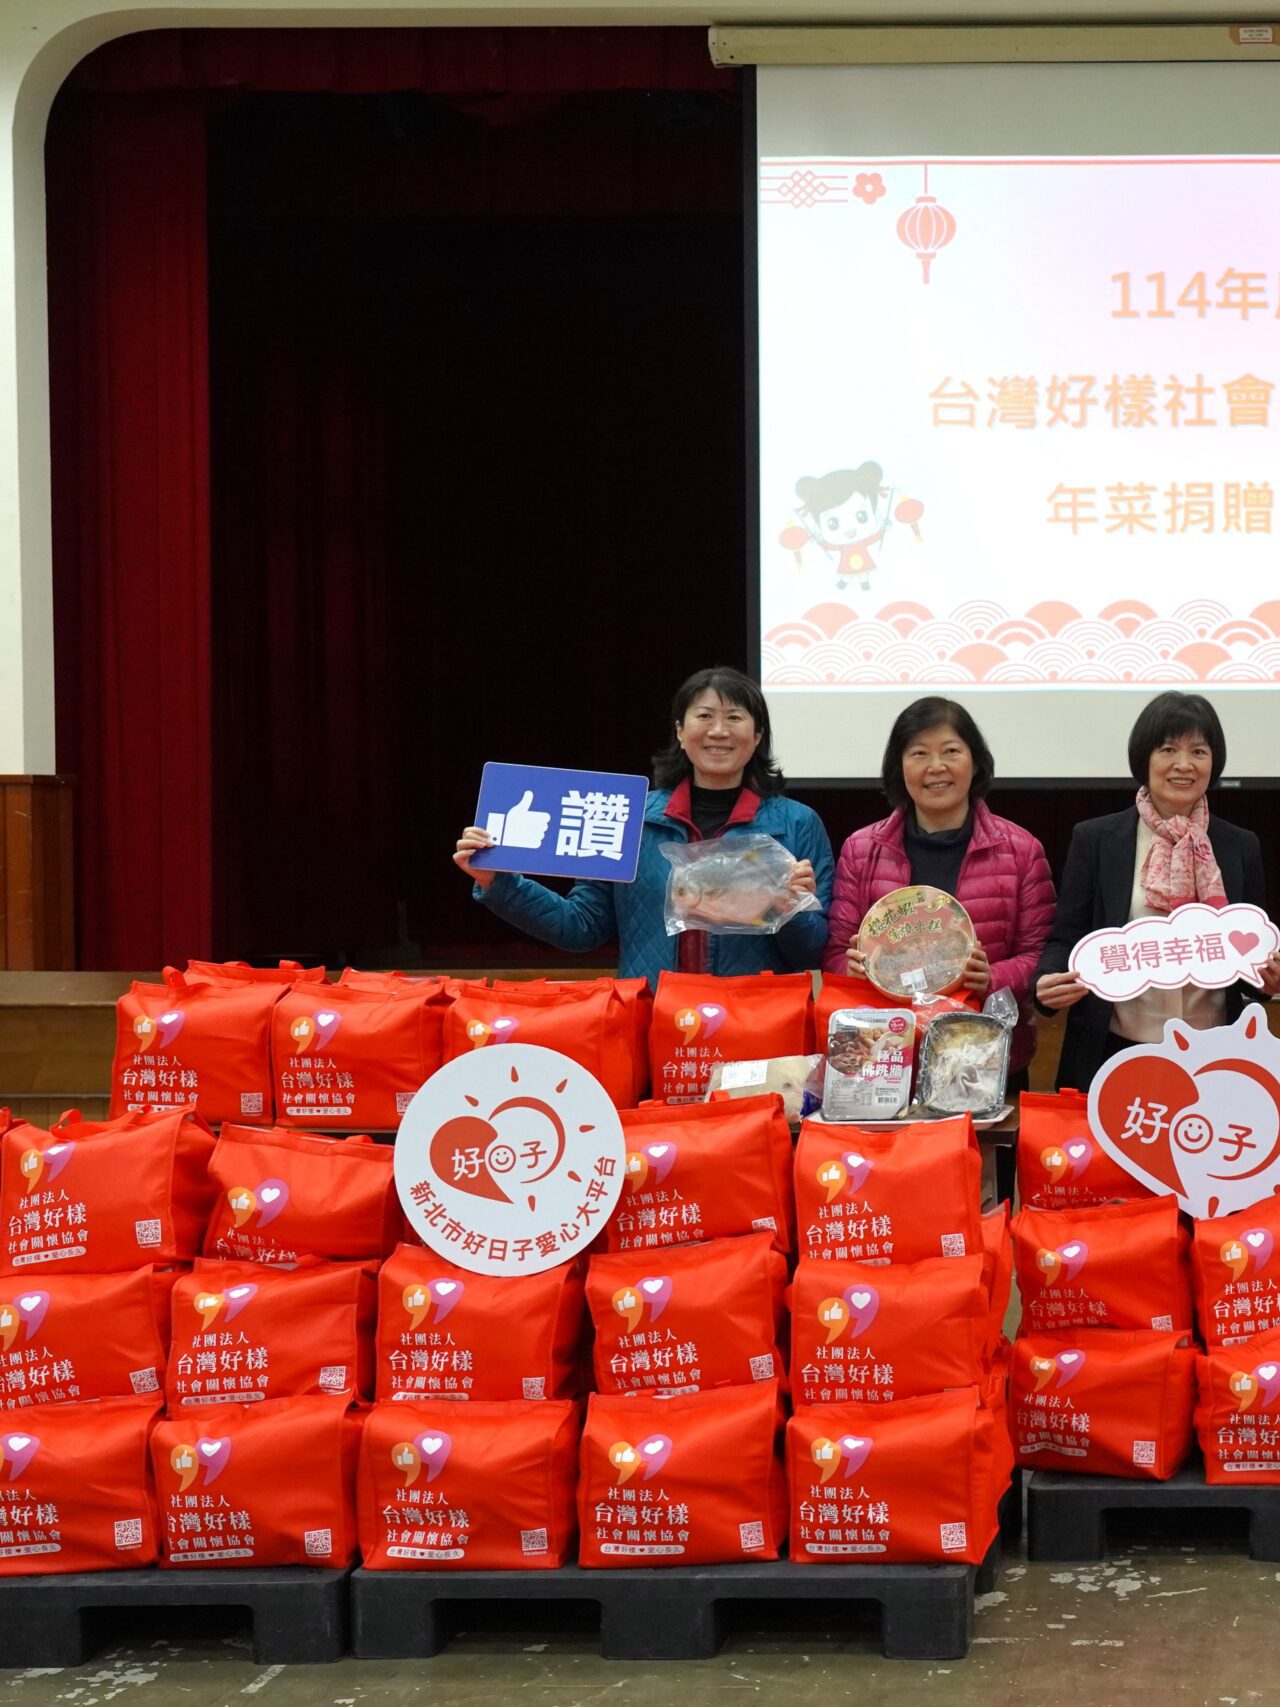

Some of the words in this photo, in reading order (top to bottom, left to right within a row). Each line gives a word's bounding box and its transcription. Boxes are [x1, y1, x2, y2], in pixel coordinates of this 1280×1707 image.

[556, 790, 630, 861] 讚
[1099, 928, 1226, 973] 覺得幸福
[133, 1055, 182, 1066] 社團法人
[674, 1046, 723, 1058] 社團法人
[289, 1057, 336, 1069] 社團法人
[662, 1061, 712, 1079] 台灣好
[122, 1069, 198, 1087] 台灣好樣
[281, 1072, 355, 1088] 台灣好樣
[123, 1089, 199, 1103] 社會關懷協會
[282, 1093, 355, 1104] 社會關懷協會
[19, 1189, 69, 1209] 社團法人
[410, 1155, 617, 1260] 新北市好日子愛心大平台
[626, 1190, 684, 1208] 社團法人
[616, 1204, 702, 1233] 台灣好樣
[818, 1201, 873, 1219] 社團法人
[8, 1203, 87, 1237] 台灣好樣
[620, 1228, 705, 1249] 社會關懷協會
[806, 1216, 893, 1245] 台灣好樣
[8, 1228, 89, 1254] 社會關懷協會
[1224, 1279, 1278, 1295] 社團法人
[192, 1331, 250, 1348] 社團法人
[400, 1333, 456, 1347] 社團法人
[618, 1329, 677, 1349] 社團法人
[177, 1347, 269, 1375] 台灣好樣
[388, 1350, 473, 1372] 台灣好樣
[610, 1342, 699, 1375] 台灣好樣
[815, 1346, 876, 1360] 社團法人
[391, 1375, 473, 1390] 社會關懷協會
[616, 1367, 701, 1390] 社會關懷協會
[800, 1364, 894, 1385] 台灣好樣
[176, 1375, 269, 1393] 社會關懷協會
[170, 1495, 230, 1508] 社團法人
[396, 1488, 449, 1506] 社團法人
[608, 1487, 670, 1501] 社團法人
[809, 1485, 870, 1500] 社團法人
[382, 1505, 470, 1528] 台灣好樣
[594, 1503, 690, 1525] 台灣好樣
[799, 1501, 890, 1525] 台灣好樣
[167, 1512, 251, 1533] 台灣好樣
[386, 1529, 469, 1546] 社會關懷協會
[596, 1528, 690, 1542] 社會關懷協會
[800, 1526, 890, 1542] 社會關懷協會
[168, 1536, 254, 1551] 社會關懷協會
